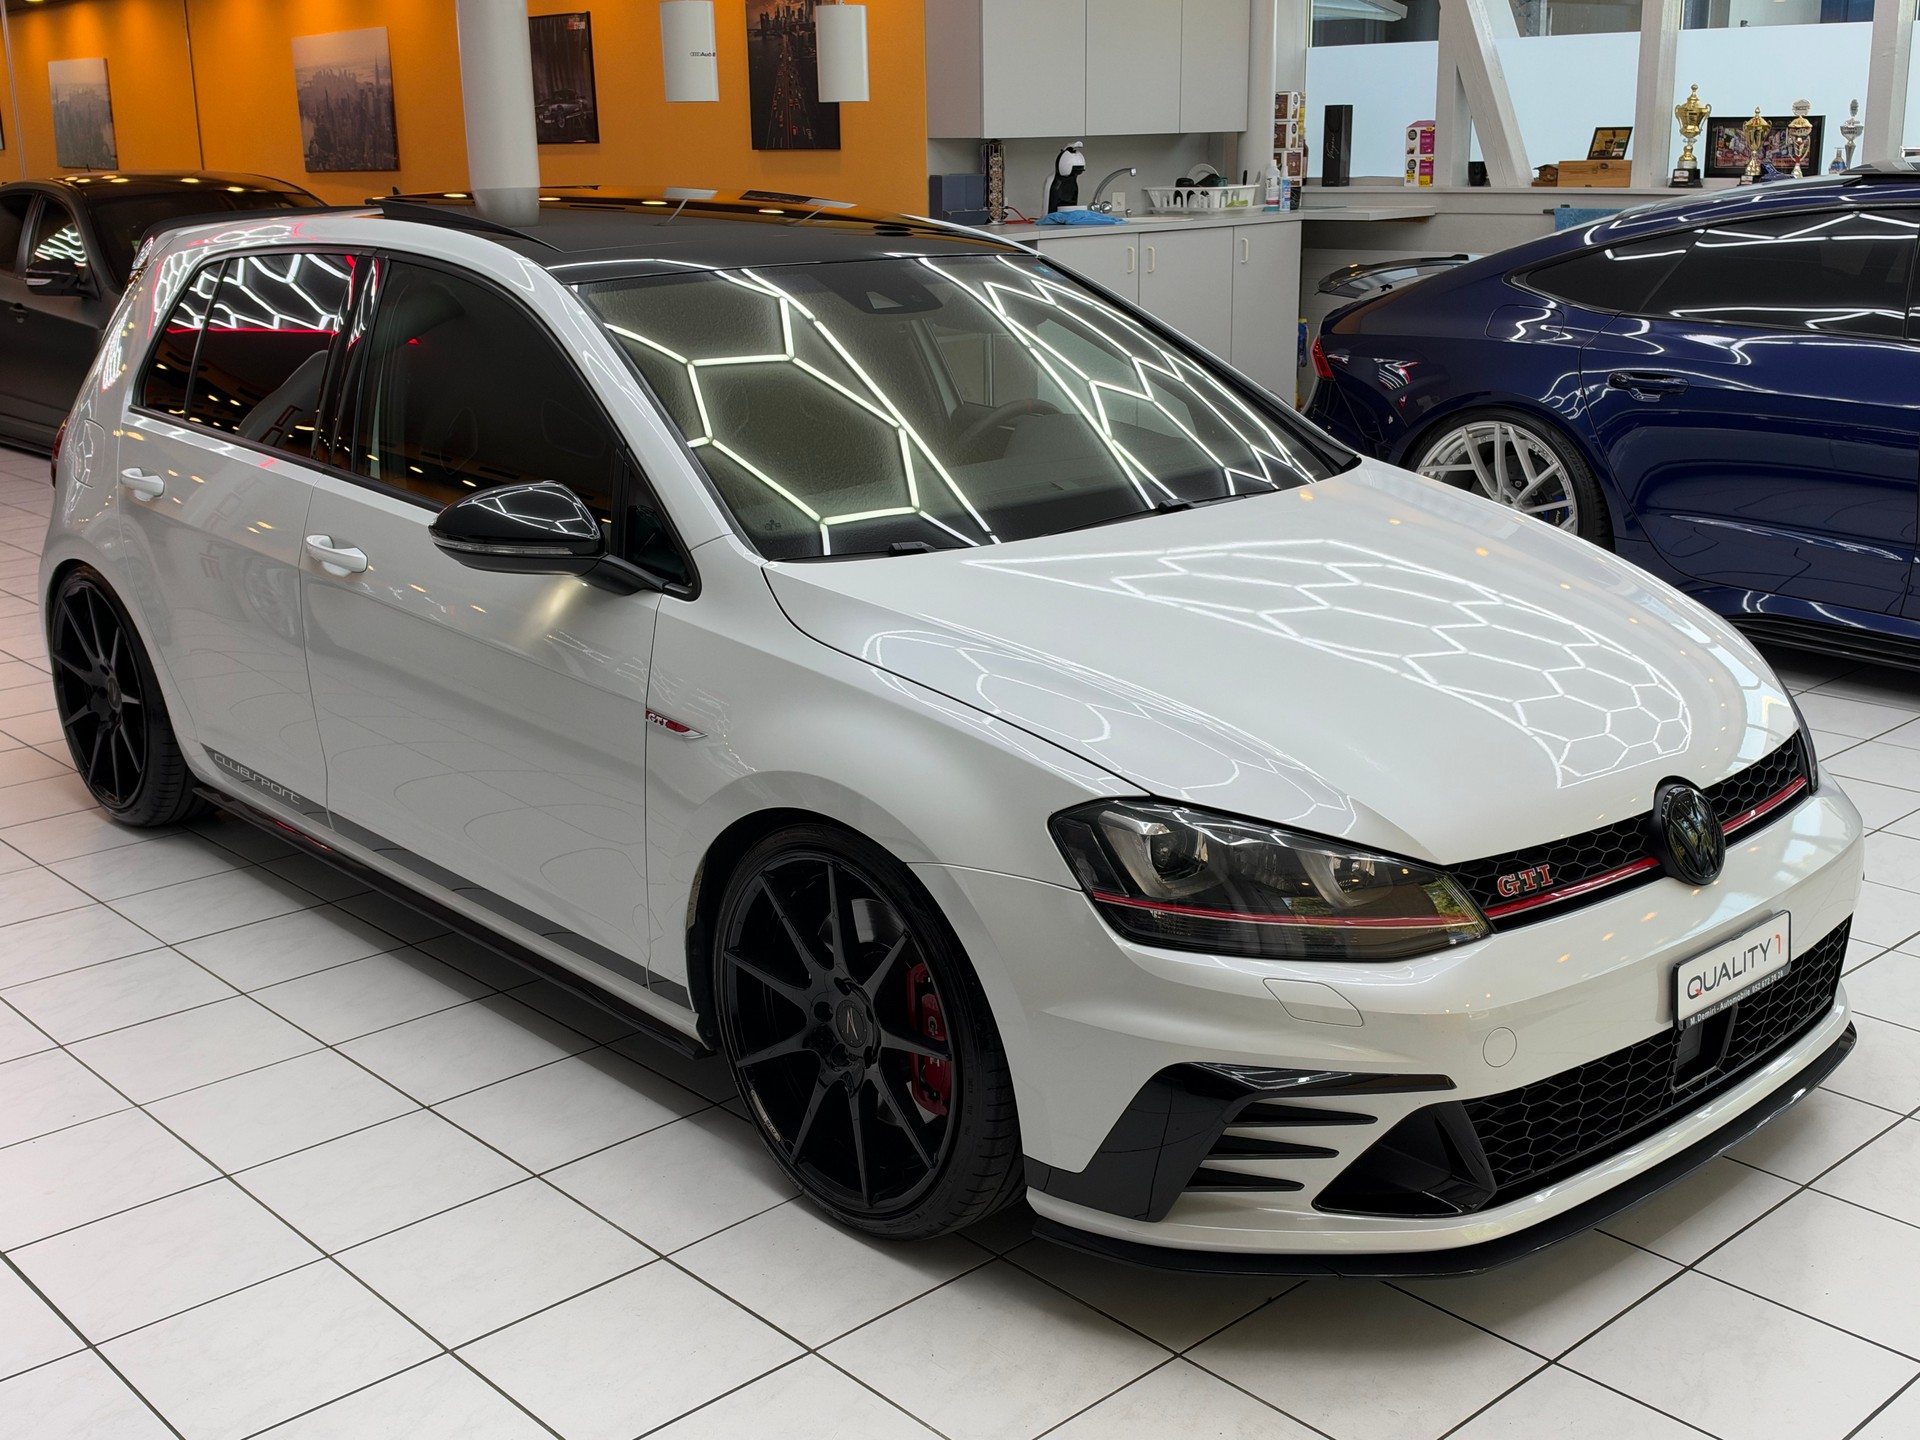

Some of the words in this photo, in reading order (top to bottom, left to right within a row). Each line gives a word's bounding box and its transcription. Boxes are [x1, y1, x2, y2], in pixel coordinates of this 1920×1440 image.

[648, 713, 668, 727] GTI
[1497, 864, 1553, 897] GTI
[1720, 989, 1751, 1011] Automobile
